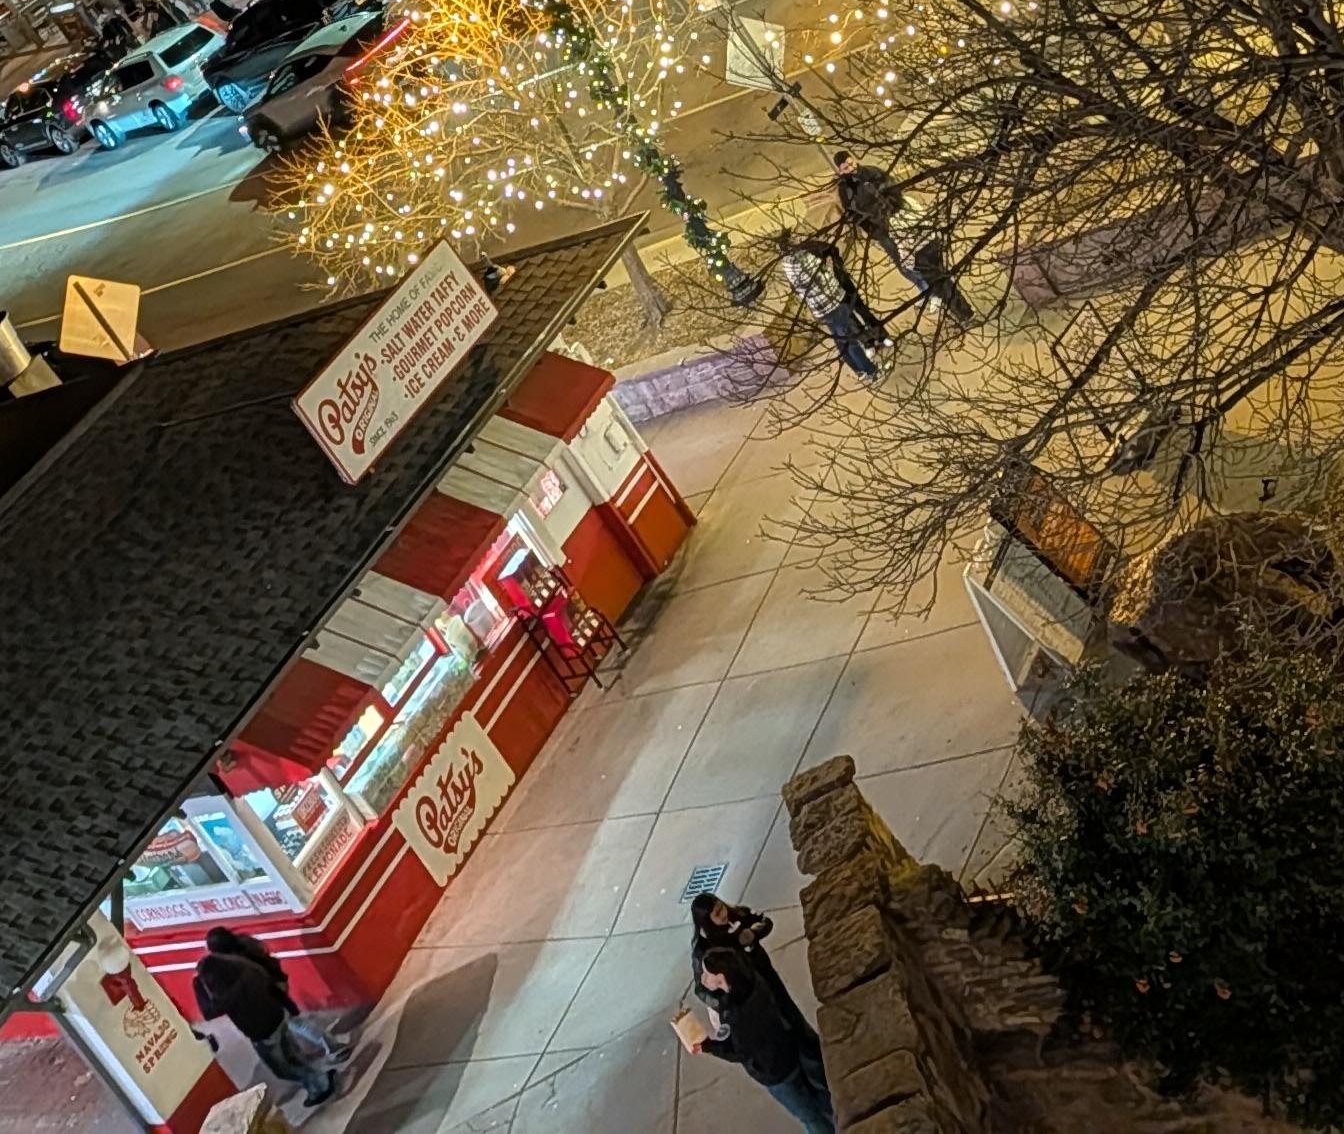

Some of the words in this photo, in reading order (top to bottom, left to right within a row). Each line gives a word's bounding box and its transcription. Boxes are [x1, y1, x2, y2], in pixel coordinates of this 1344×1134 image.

[368, 327, 389, 344] THE
[387, 299, 411, 326] HOME
[409, 282, 426, 302] OF
[381, 331, 406, 364] SALT
[402, 300, 436, 340] WATER
[431, 269, 460, 308] TAFFY
[394, 327, 439, 381] GOURMET
[436, 281, 477, 336] POPCORN
[405, 376, 423, 399] ICE
[421, 341, 456, 379] CREAM
[461, 296, 491, 334] MORE
[317, 352, 378, 446] Patsy's
[355, 389, 379, 440] ORIGINAL
[369, 425, 388, 448] SINCE
[415, 747, 484, 849] Patsy's
[310, 827, 353, 885] LEMONADE
[135, 1019, 170, 1063] NAVAJO
[143, 1028, 178, 1074] SPRING
